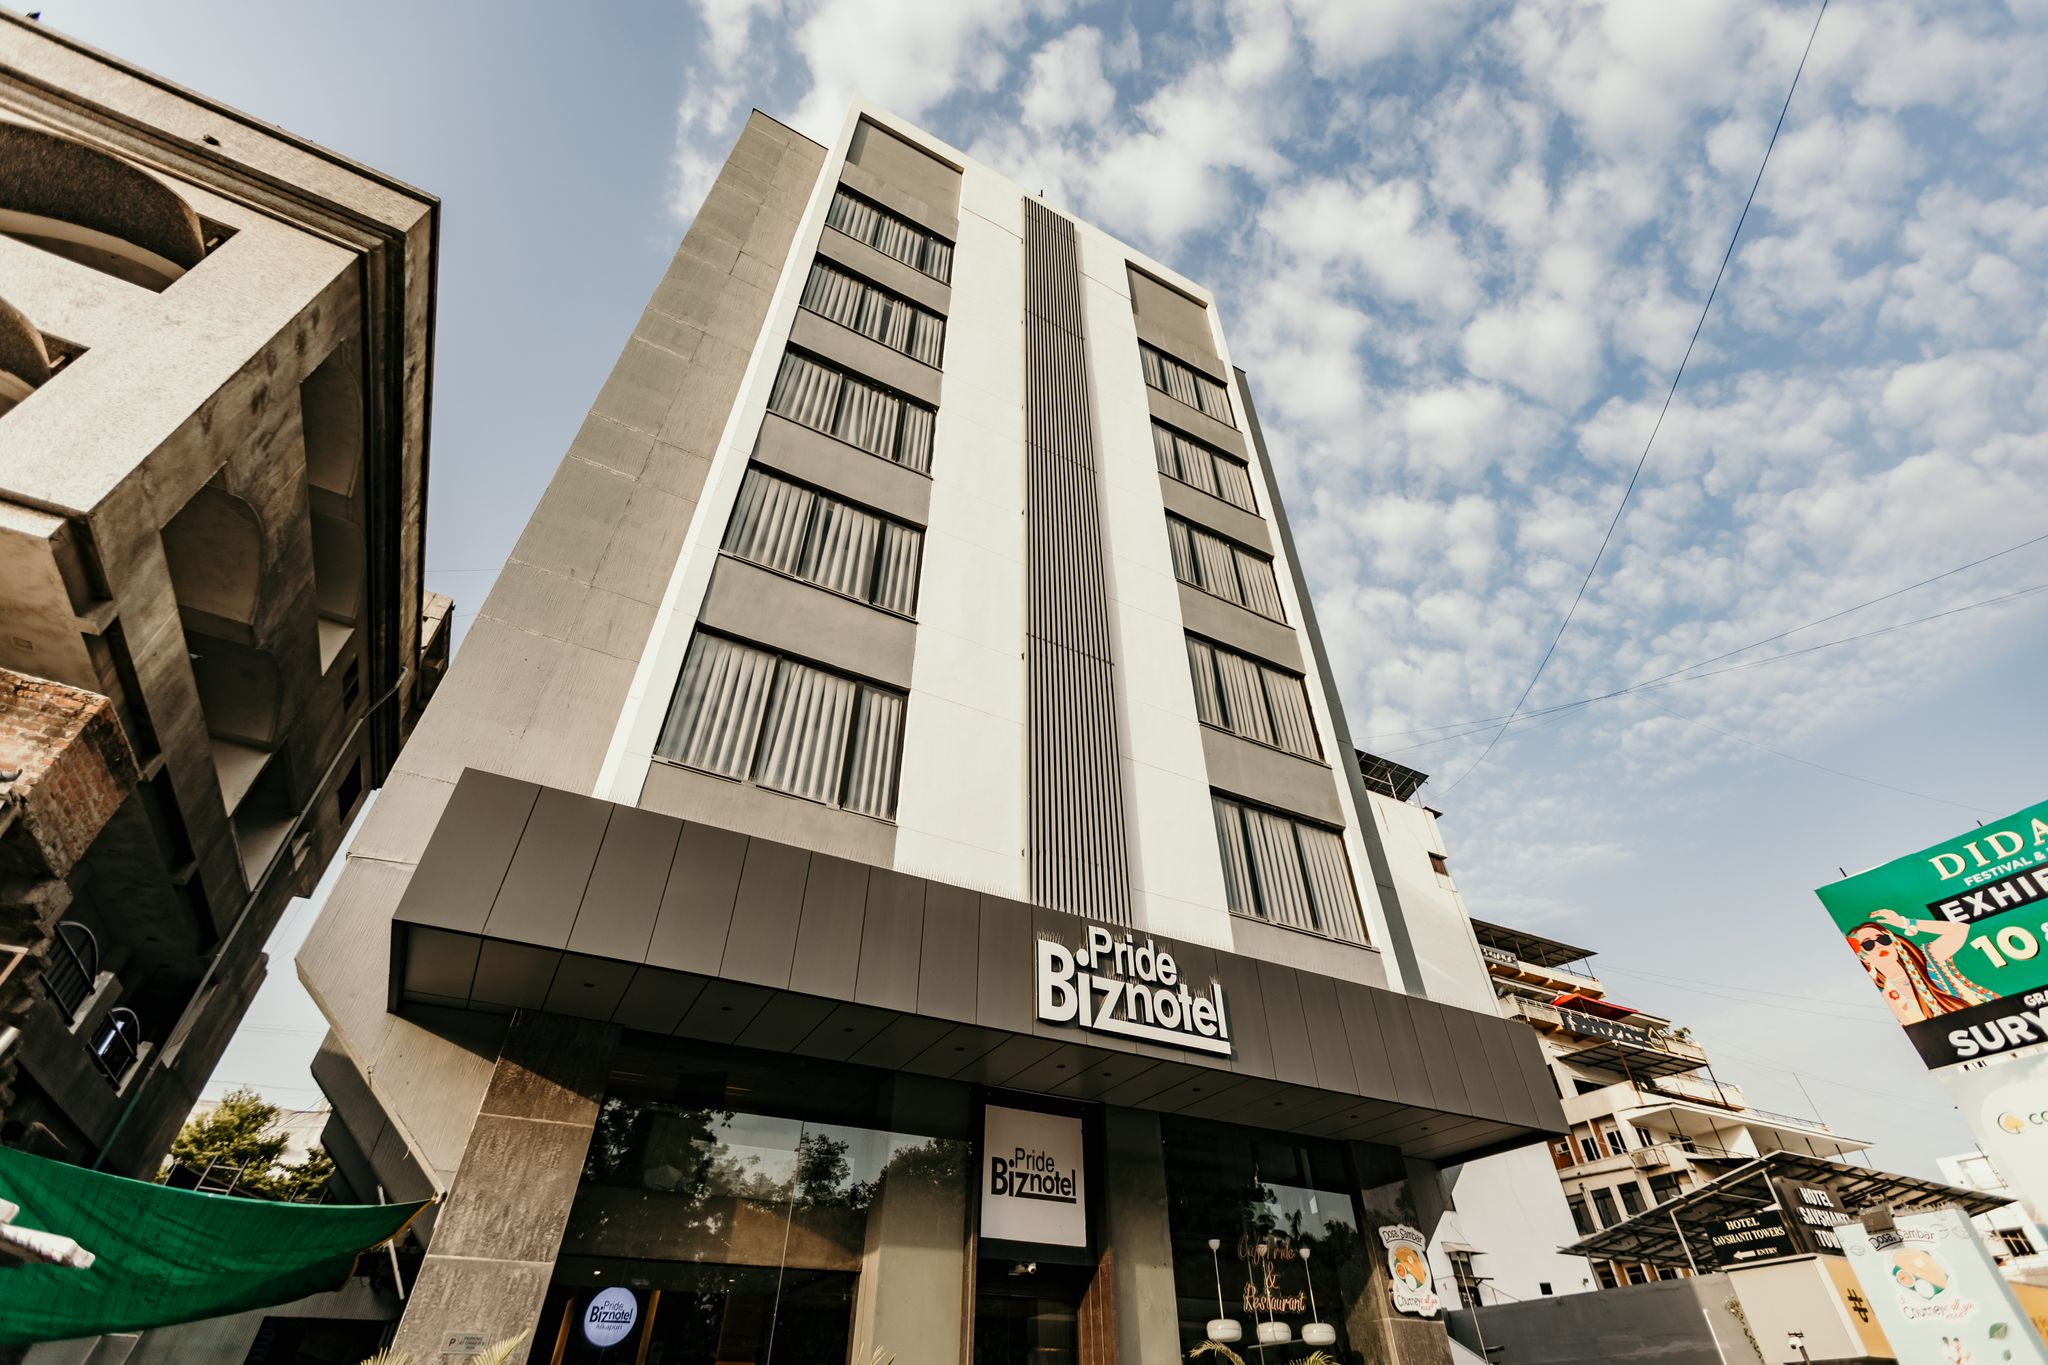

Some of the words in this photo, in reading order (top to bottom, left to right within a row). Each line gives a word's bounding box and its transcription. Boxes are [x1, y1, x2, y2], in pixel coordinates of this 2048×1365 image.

[1963, 857, 2033, 887] FESTIVAL
[2033, 851, 2046, 862] &
[1087, 925, 1177, 986] Pride
[1970, 926, 2039, 969] 10
[1037, 938, 1231, 1055] Biznotel
[1015, 1147, 1055, 1173] Pride
[991, 1156, 1077, 1204] Biznotel
[1799, 1187, 1835, 1208] HOTEL
[1399, 1228, 1423, 1243] Sambar
[1725, 1216, 1760, 1231] HOTEL
[1896, 1228, 1935, 1241] Sambar
[1712, 1231, 1752, 1247] SAVSHANTI
[1752, 1225, 1786, 1241] TOWERS
[1756, 1247, 1777, 1256] ENTRY
[1264, 1261, 1280, 1289] &
[603, 1300, 624, 1311] Pride
[1243, 1281, 1307, 1313] Restaurant
[589, 1305, 634, 1324] Biznotel
